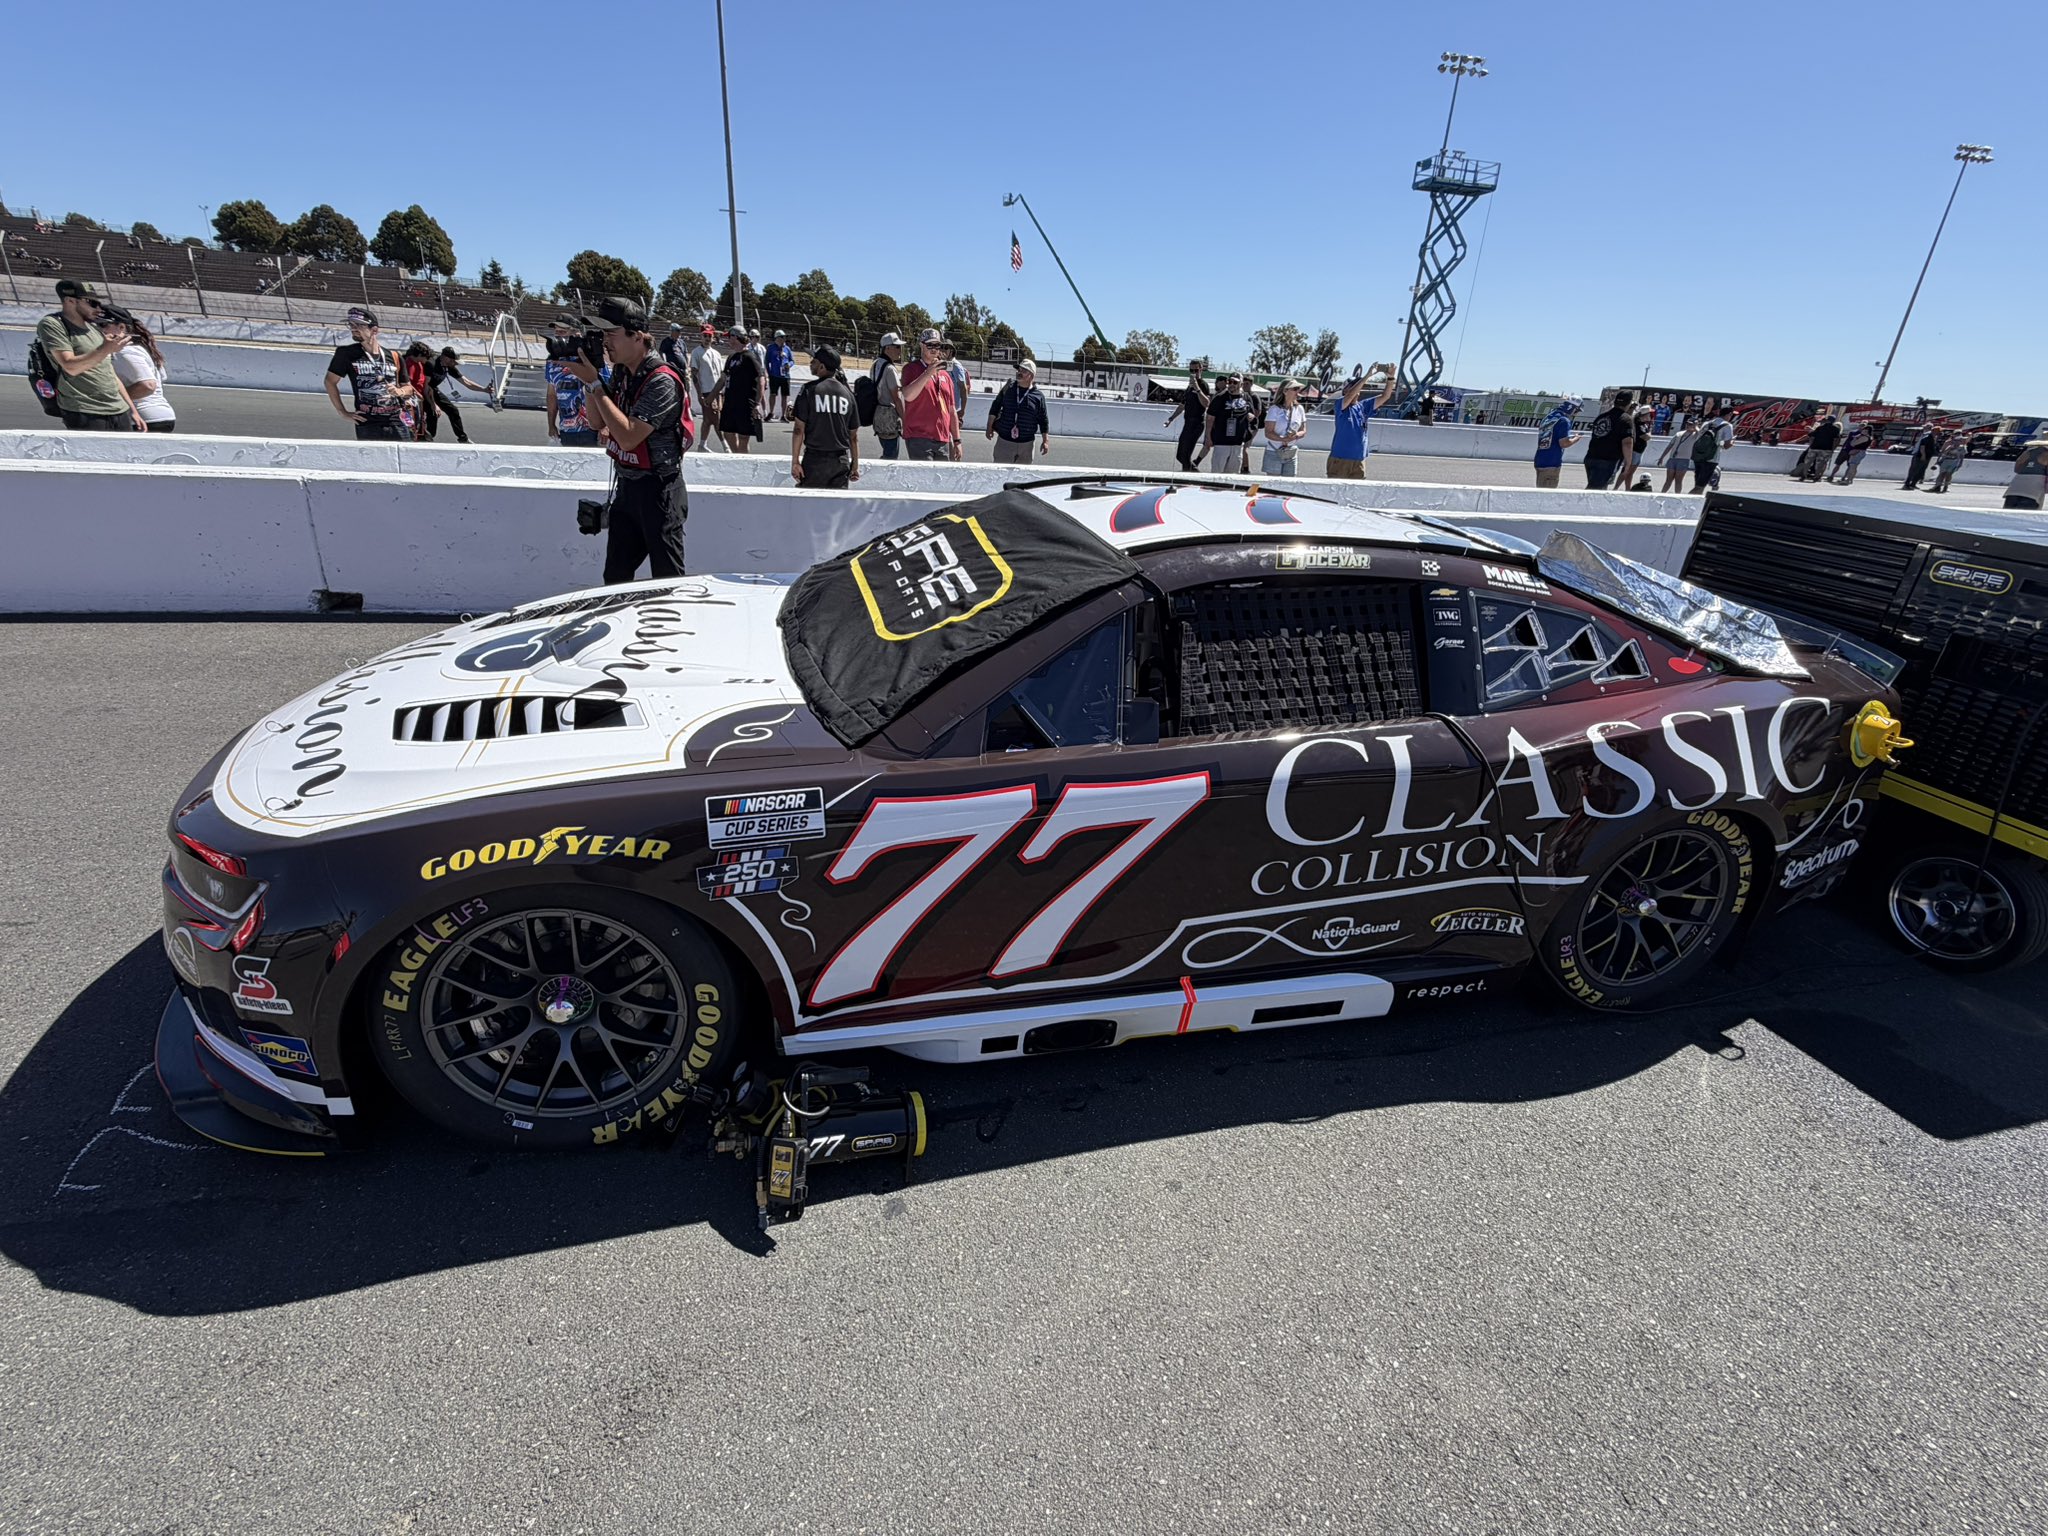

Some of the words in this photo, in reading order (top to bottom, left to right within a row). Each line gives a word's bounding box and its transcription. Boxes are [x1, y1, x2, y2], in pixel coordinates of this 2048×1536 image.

[1082, 369, 1131, 391] CEWA
[815, 394, 849, 416] MIB
[1693, 395, 1703, 406] 3
[1309, 546, 1354, 554] CARSON
[1482, 565, 1549, 590] MINER
[1435, 611, 1459, 621] TWG
[1265, 697, 1831, 847] CLASSIC
[744, 793, 807, 813] NASCAR
[724, 820, 755, 837] CUP
[757, 815, 809, 833] SERIES
[420, 828, 672, 881] GOODYEAR
[1250, 832, 1546, 897] COLLISION
[1779, 838, 1860, 889] Spectrum
[723, 860, 776, 883] 250
[807, 770, 1210, 1007] 77
[450, 898, 489, 926] LF3
[1312, 920, 1400, 940] NationsGuard
[1434, 914, 1525, 936] ZEIGLER
[382, 913, 459, 1012] EAGLE
[1407, 979, 1488, 1000] respect.
[1560, 955, 1604, 1005] EAGLE
[252, 1044, 308, 1062] SUNOCO
[809, 1134, 846, 1159] 77
[771, 1169, 791, 1185] 77
